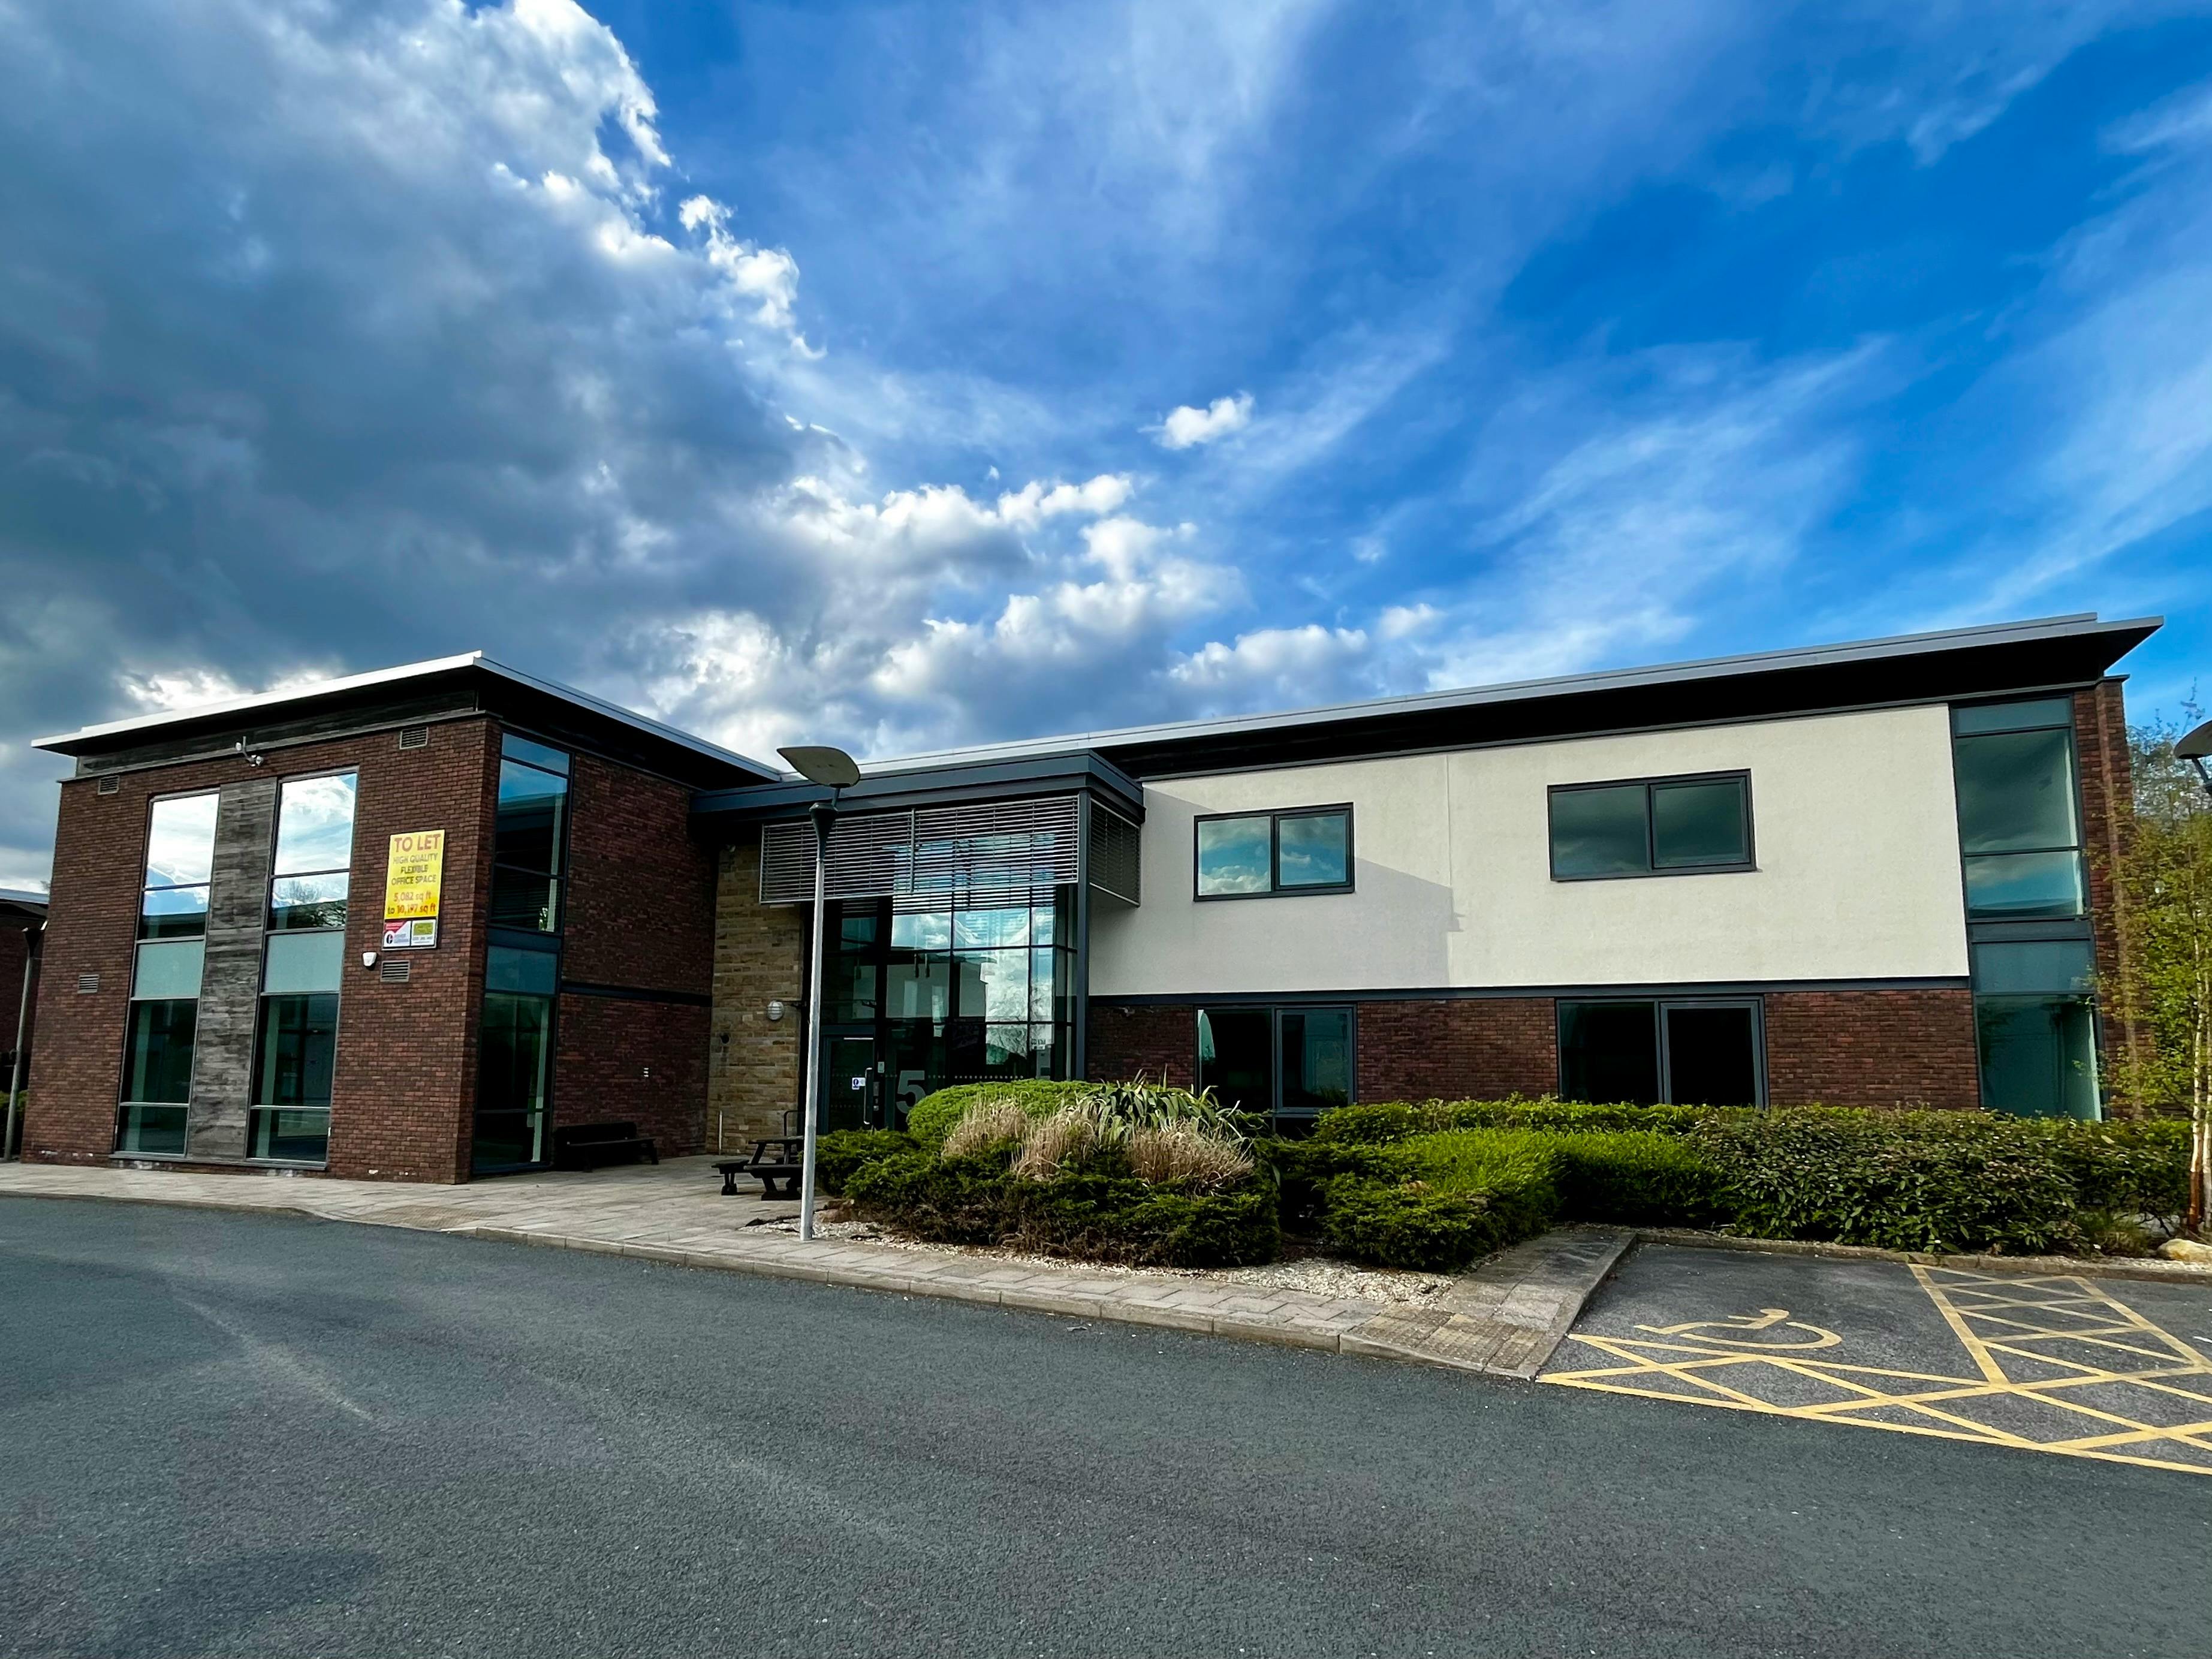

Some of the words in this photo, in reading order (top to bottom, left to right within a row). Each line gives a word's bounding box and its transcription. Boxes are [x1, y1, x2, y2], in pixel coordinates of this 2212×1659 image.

[394, 836, 412, 853] TO
[417, 834, 441, 851] LET
[393, 856, 408, 864] HIGH
[410, 853, 438, 863] QUALITY
[401, 865, 428, 874] FLEXIBLE
[391, 877, 414, 886] OFFICE
[415, 875, 436, 884] SPACE
[415, 893, 424, 902] sq
[426, 890, 432, 900] ft
[387, 906, 395, 915] to
[420, 905, 428, 915] sq
[430, 903, 436, 912] ft
[896, 1070, 926, 1114] 5
